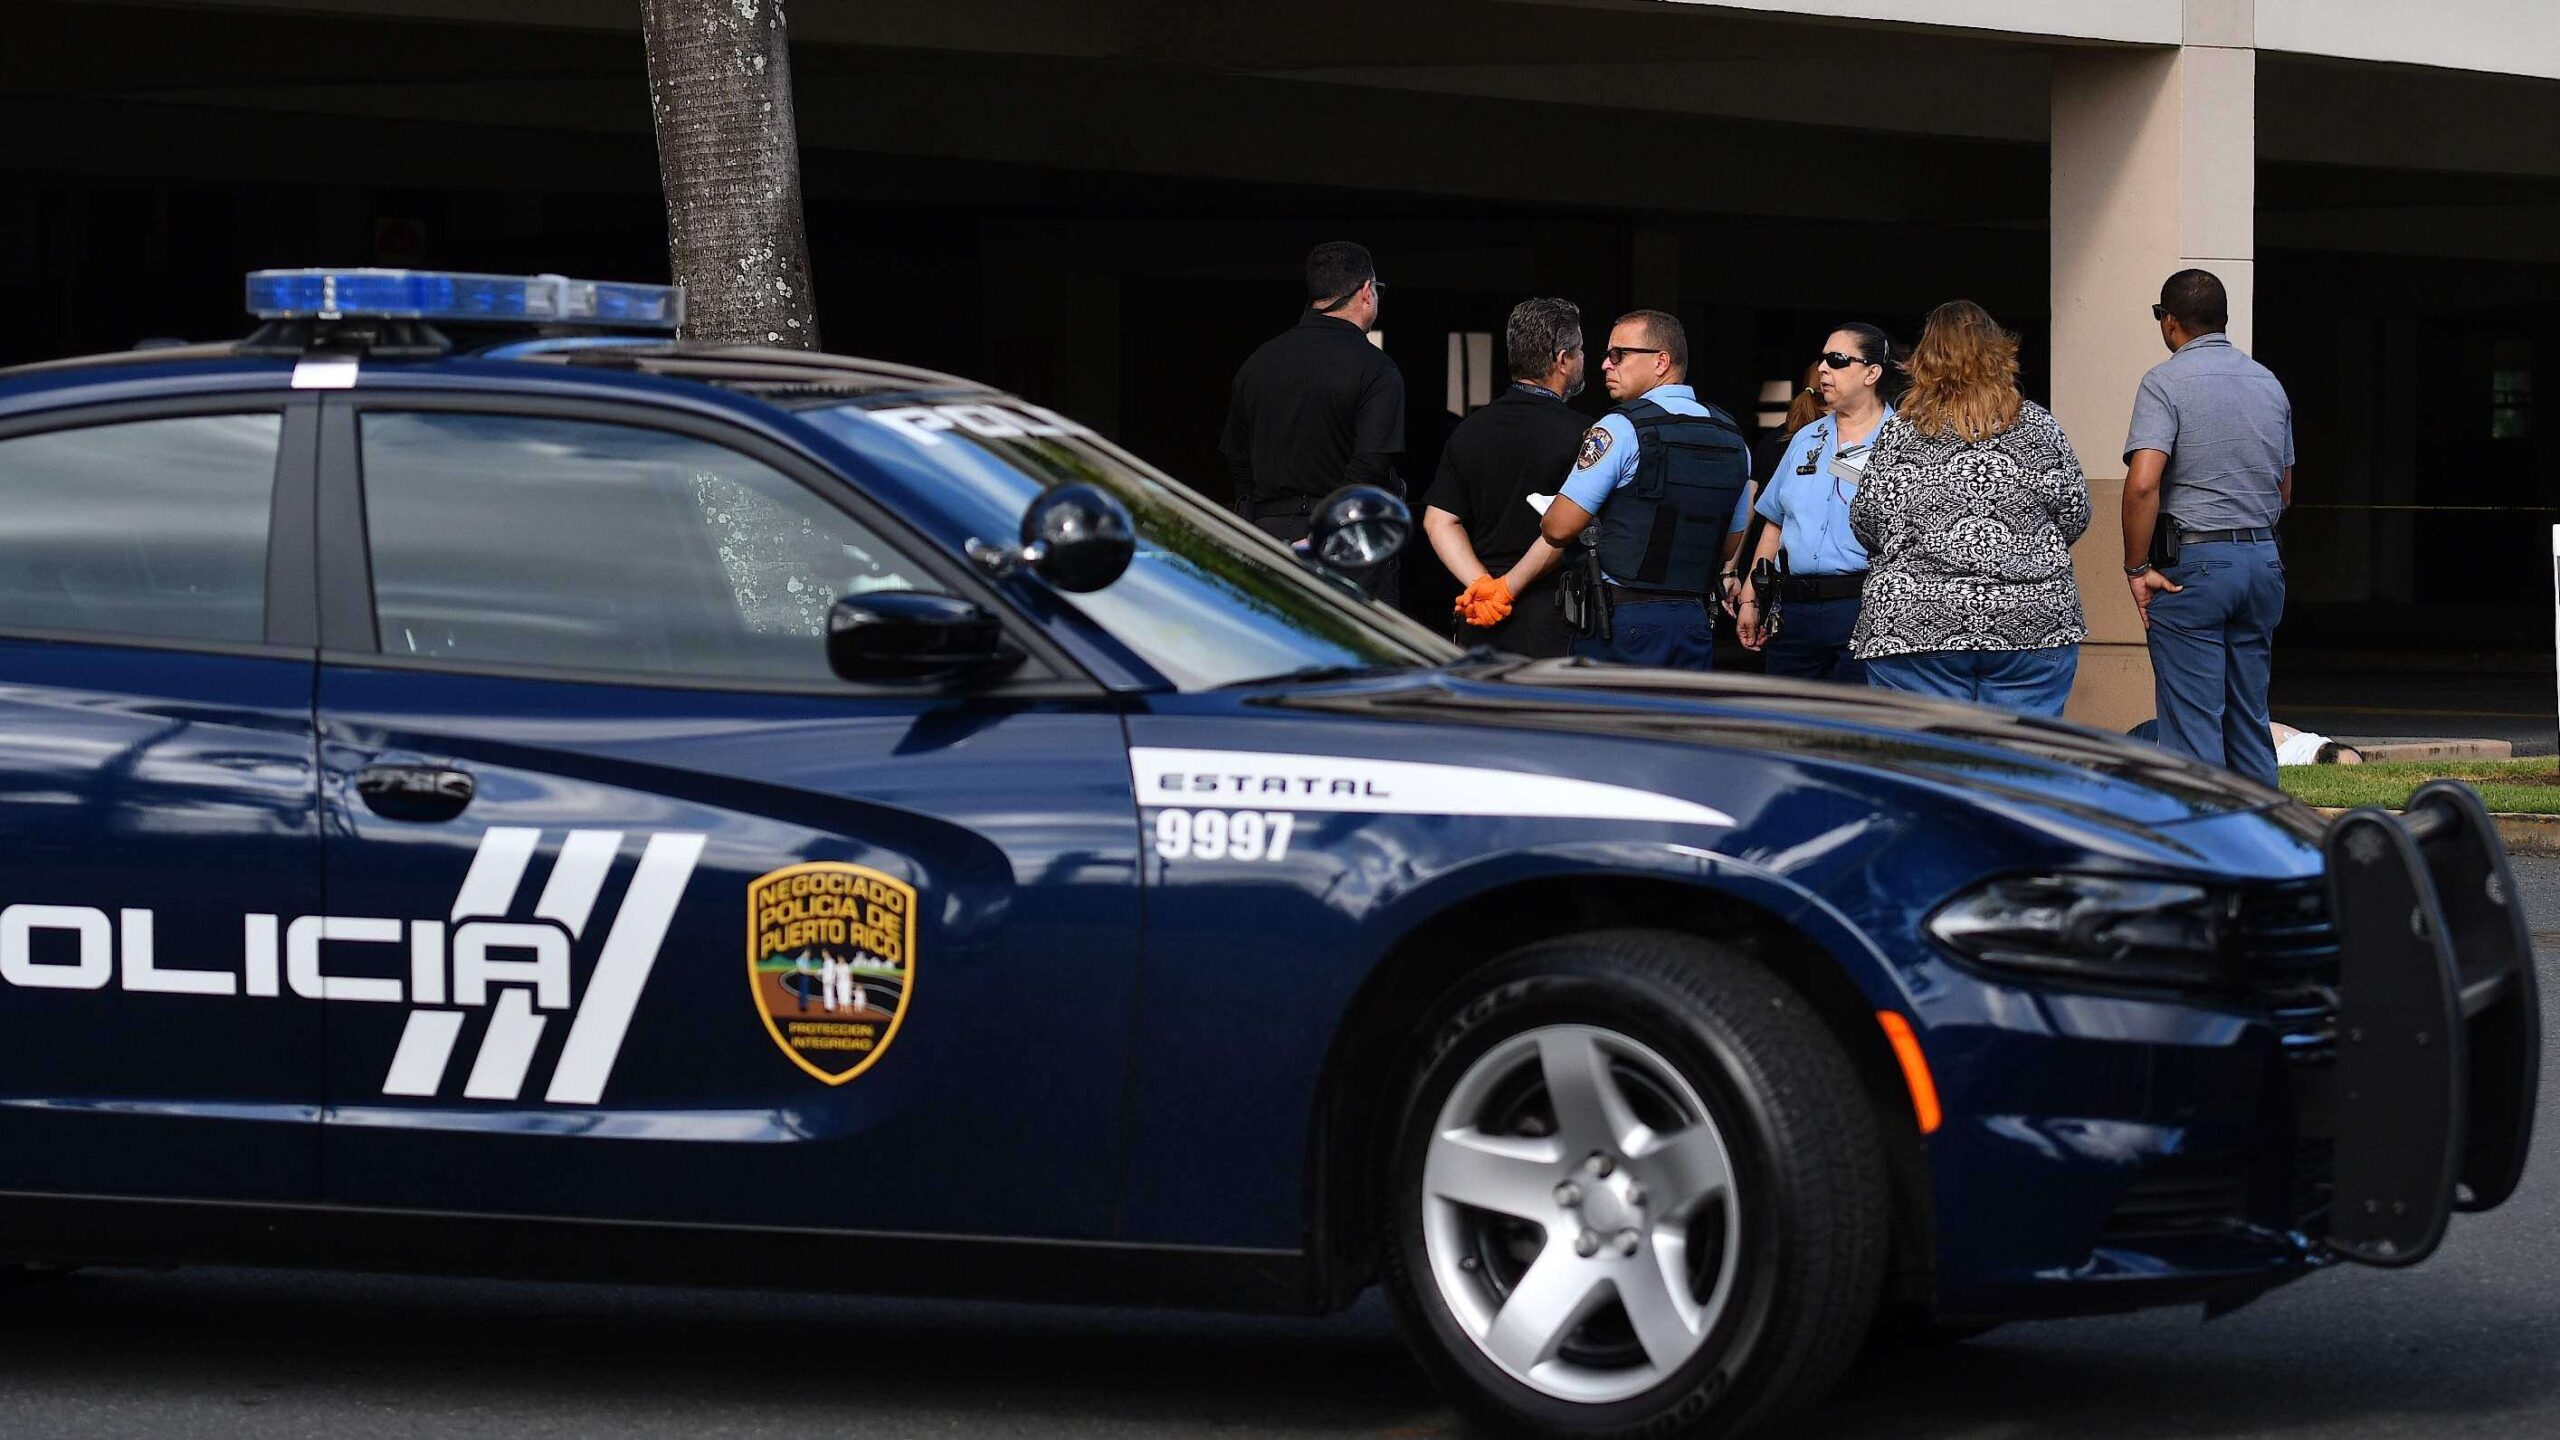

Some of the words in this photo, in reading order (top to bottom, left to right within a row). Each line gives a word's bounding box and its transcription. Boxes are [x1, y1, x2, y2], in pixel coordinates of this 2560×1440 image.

[1159, 773, 1390, 796] ESTATAL
[1155, 808, 1296, 862] 9997
[759, 872, 905, 914] NEGOCIADO
[760, 894, 860, 932] POLICIA
[866, 902, 903, 935] DE
[760, 917, 846, 960] PUERTO
[850, 919, 902, 963] RICO
[788, 1022, 875, 1037] PROTECCION
[791, 1036, 873, 1051] INTEGRIDAD
